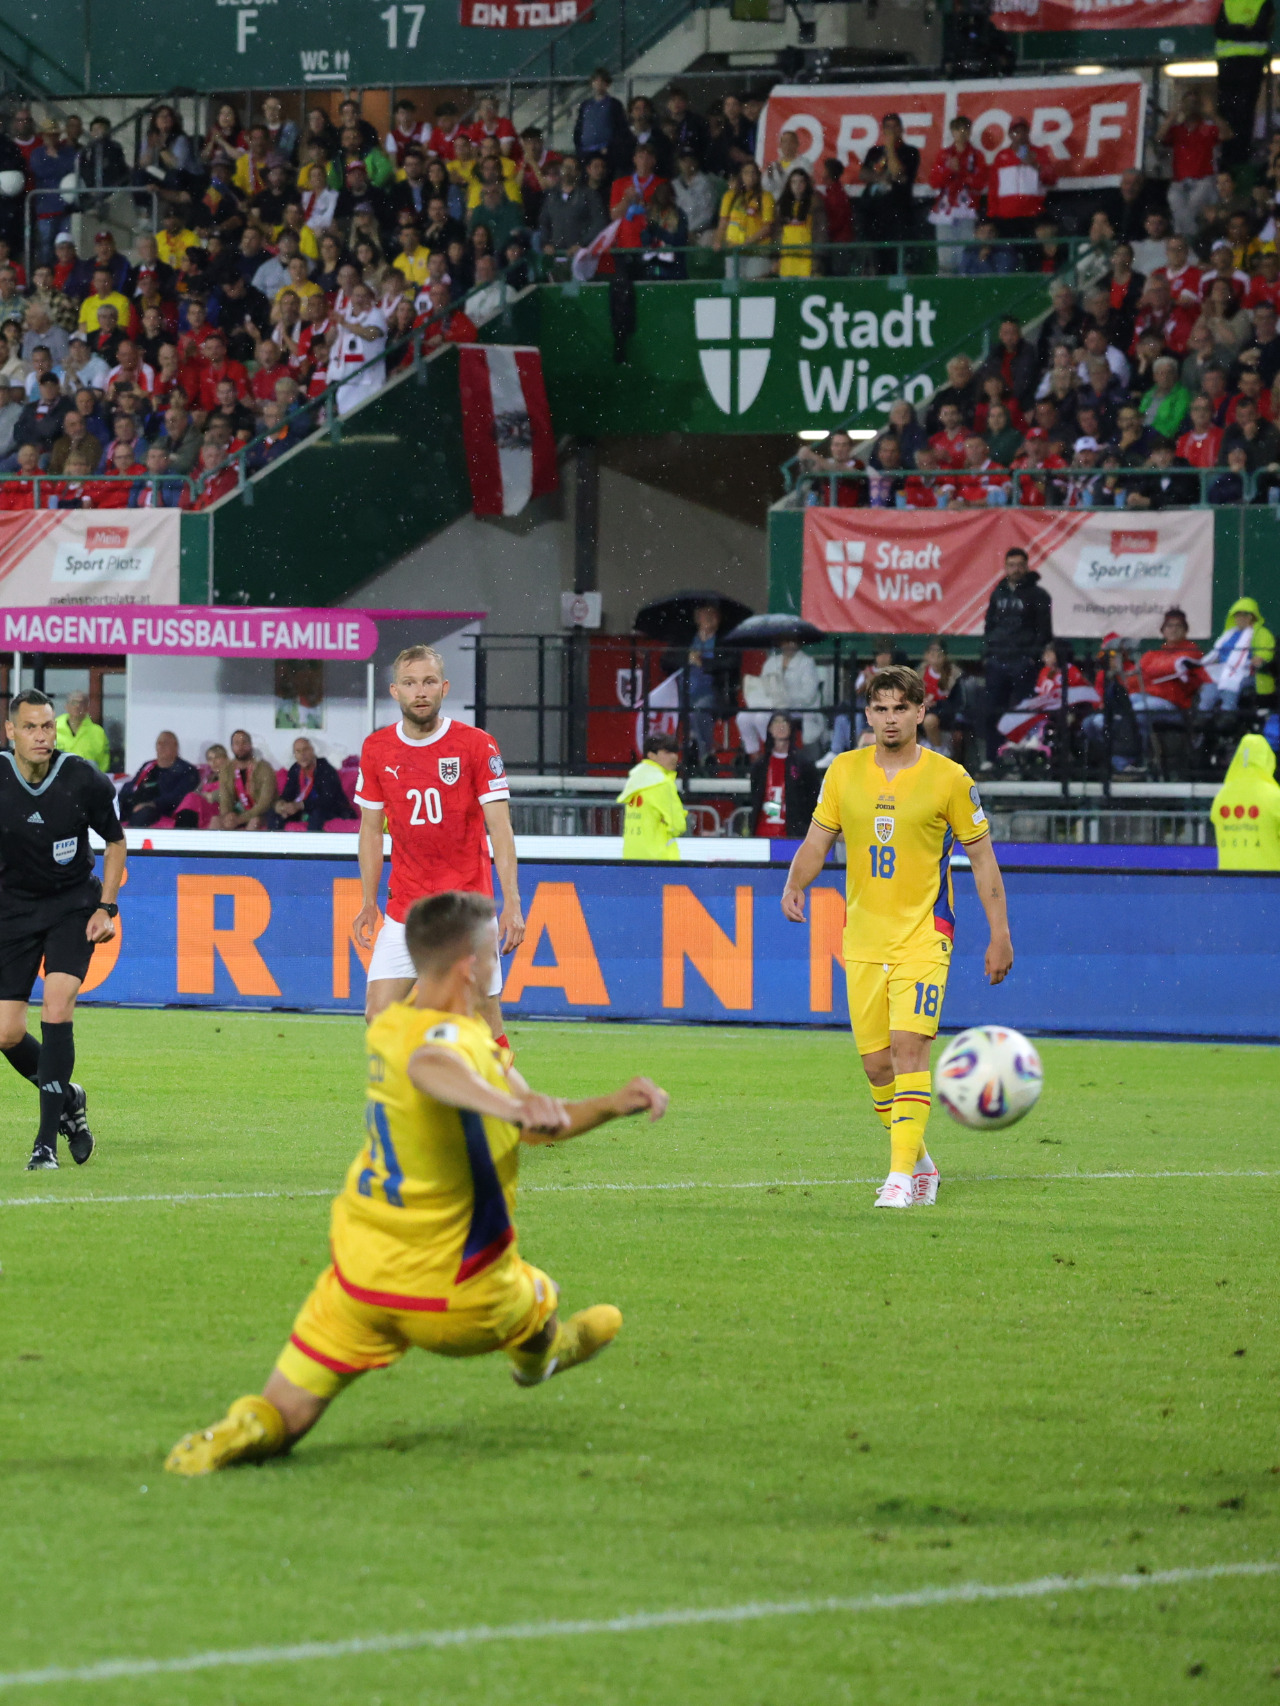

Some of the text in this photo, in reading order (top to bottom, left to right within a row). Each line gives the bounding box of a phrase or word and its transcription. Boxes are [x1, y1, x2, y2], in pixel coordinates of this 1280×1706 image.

[237, 9, 258, 53] F
[381, 5, 425, 48] 17
[472, 2, 577, 26] ON TOUR
[300, 51, 329, 71] WC
[800, 293, 936, 350] Stadt
[798, 358, 934, 413] Wien
[65, 555, 142, 575] Sport Platz
[874, 541, 942, 570] Stadt
[1088, 560, 1131, 581] Sport
[875, 572, 943, 603] Wien
[4, 614, 360, 650] MAGENTA FUSSBALL FAMILIE
[406, 787, 443, 826] 20
[55, 839, 75, 850] FIFA
[869, 845, 896, 879] 18
[914, 981, 939, 1018] 18
